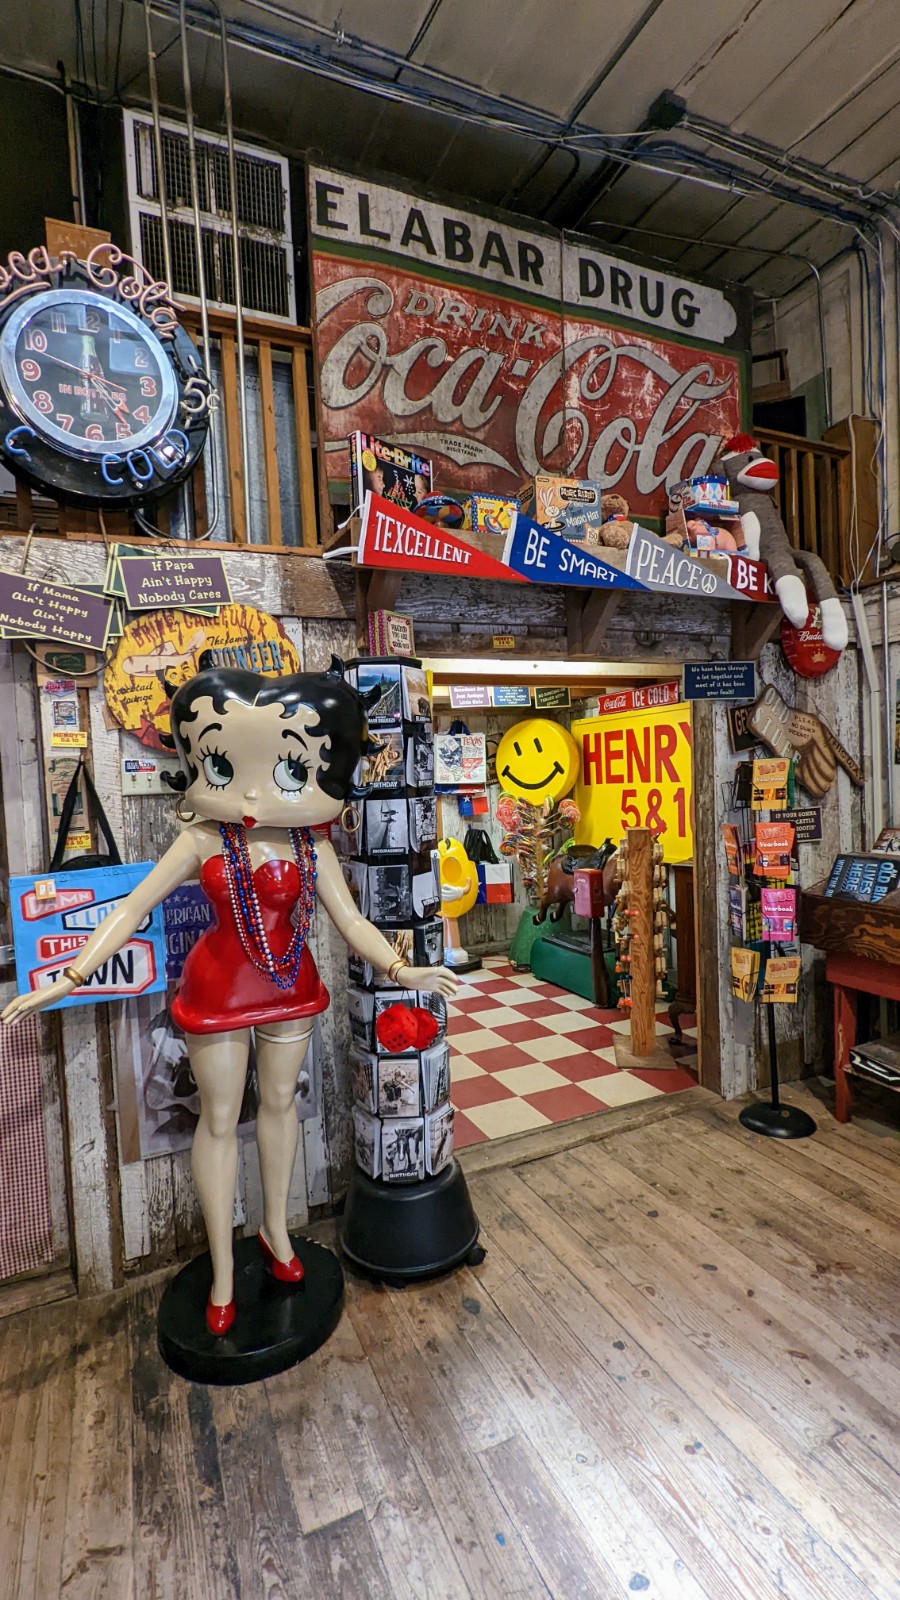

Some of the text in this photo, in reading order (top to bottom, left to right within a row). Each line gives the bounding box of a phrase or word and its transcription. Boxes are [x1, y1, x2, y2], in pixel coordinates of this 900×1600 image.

[315, 180, 701, 329] ELABAR DRUG
[78, 312, 101, 333] 12
[403, 288, 549, 349] DRINK
[24, 329, 48, 353] 10
[135, 349, 151, 367] 2
[21, 359, 42, 381] 9
[58, 383, 127, 402] IN BOTTES
[139, 377, 157, 397] 3
[32, 391, 54, 414] 8
[56, 413, 75, 432] 7
[133, 405, 152, 425] 4
[85, 423, 104, 442] 6
[116, 422, 133, 441] 5
[440, 438, 484, 454] TRADE MARK
[102, 428, 189, 486] COLD
[479, 507, 495, 515] TOP
[374, 511, 472, 565] TEXCELLENT
[523, 528, 619, 583] BE SMART
[635, 538, 702, 590] PEACE
[152, 561, 195, 573] If Papa
[737, 558, 758, 591] BE
[27, 582, 80, 602] If Mama
[141, 575, 213, 588] Ain't Happy
[11, 592, 89, 618] Ain't Happy
[138, 590, 221, 604] Nobody Cares
[33, 609, 65, 622] Ain't
[0, 613, 92, 643] Nobody Happy
[210, 640, 285, 673] IONEER
[631, 690, 645, 708] ICE
[647, 685, 669, 705] COLD
[765, 687, 790, 724] OLD
[462, 736, 483, 747] TEXAS
[759, 840, 789, 848] Yearbook
[833, 860, 846, 876] WITH
[845, 862, 864, 891] HERE
[860, 862, 879, 895] LIVES
[877, 862, 895, 884] OLD
[828, 876, 840, 888] THE
[163, 904, 210, 926] ERICAN
[44, 936, 88, 955] THIS
[46, 949, 134, 987] TWN
